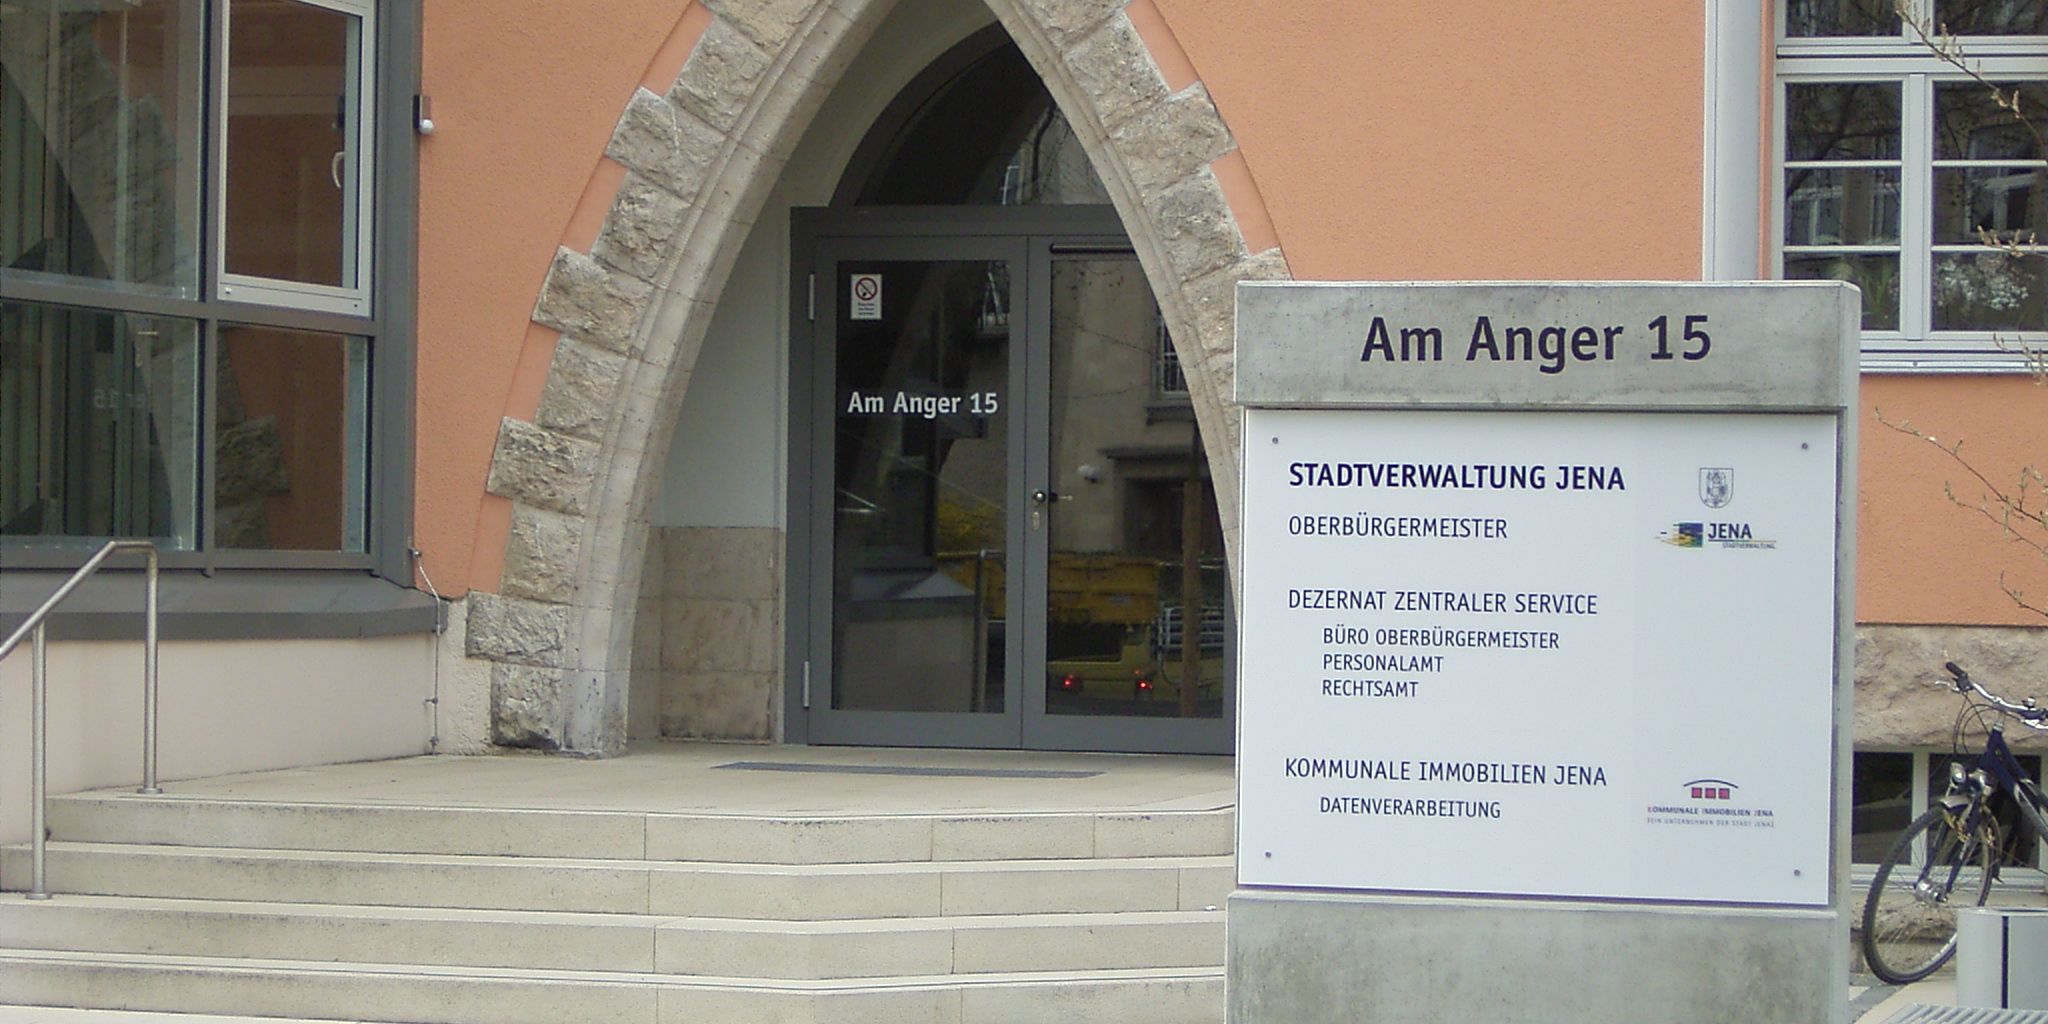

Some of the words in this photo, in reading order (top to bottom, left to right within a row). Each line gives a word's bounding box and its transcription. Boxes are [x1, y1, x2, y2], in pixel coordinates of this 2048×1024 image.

[1360, 316, 1443, 362] Am
[1465, 315, 1625, 375] Anger
[1647, 314, 1711, 361] 15
[847, 391, 884, 413] Am
[892, 391, 962, 419] Anger
[970, 392, 998, 414] 15
[1289, 461, 1546, 490] STADTVERWALTUNG
[1555, 465, 1626, 491] JENA
[1288, 511, 1508, 539] OBERBÜRGERMEISTER
[1707, 522, 1753, 539] JENA
[1288, 589, 1388, 611] DEZERNAT
[1393, 591, 1507, 613] ZENTRALER
[1514, 593, 1598, 615] SERVICE
[1322, 623, 1369, 646] BÜRO
[1375, 625, 1560, 650] OBERBÜRGERMEISTER
[1322, 653, 1445, 673] PERSONALAMT
[1322, 679, 1419, 698] RECHTSAMT
[1285, 757, 1411, 781] KOMMUNALE
[1418, 761, 1546, 785] IMMOBILIEN
[1553, 765, 1607, 787] JENA
[1320, 796, 1501, 819] DATENVERARBEITUNG
